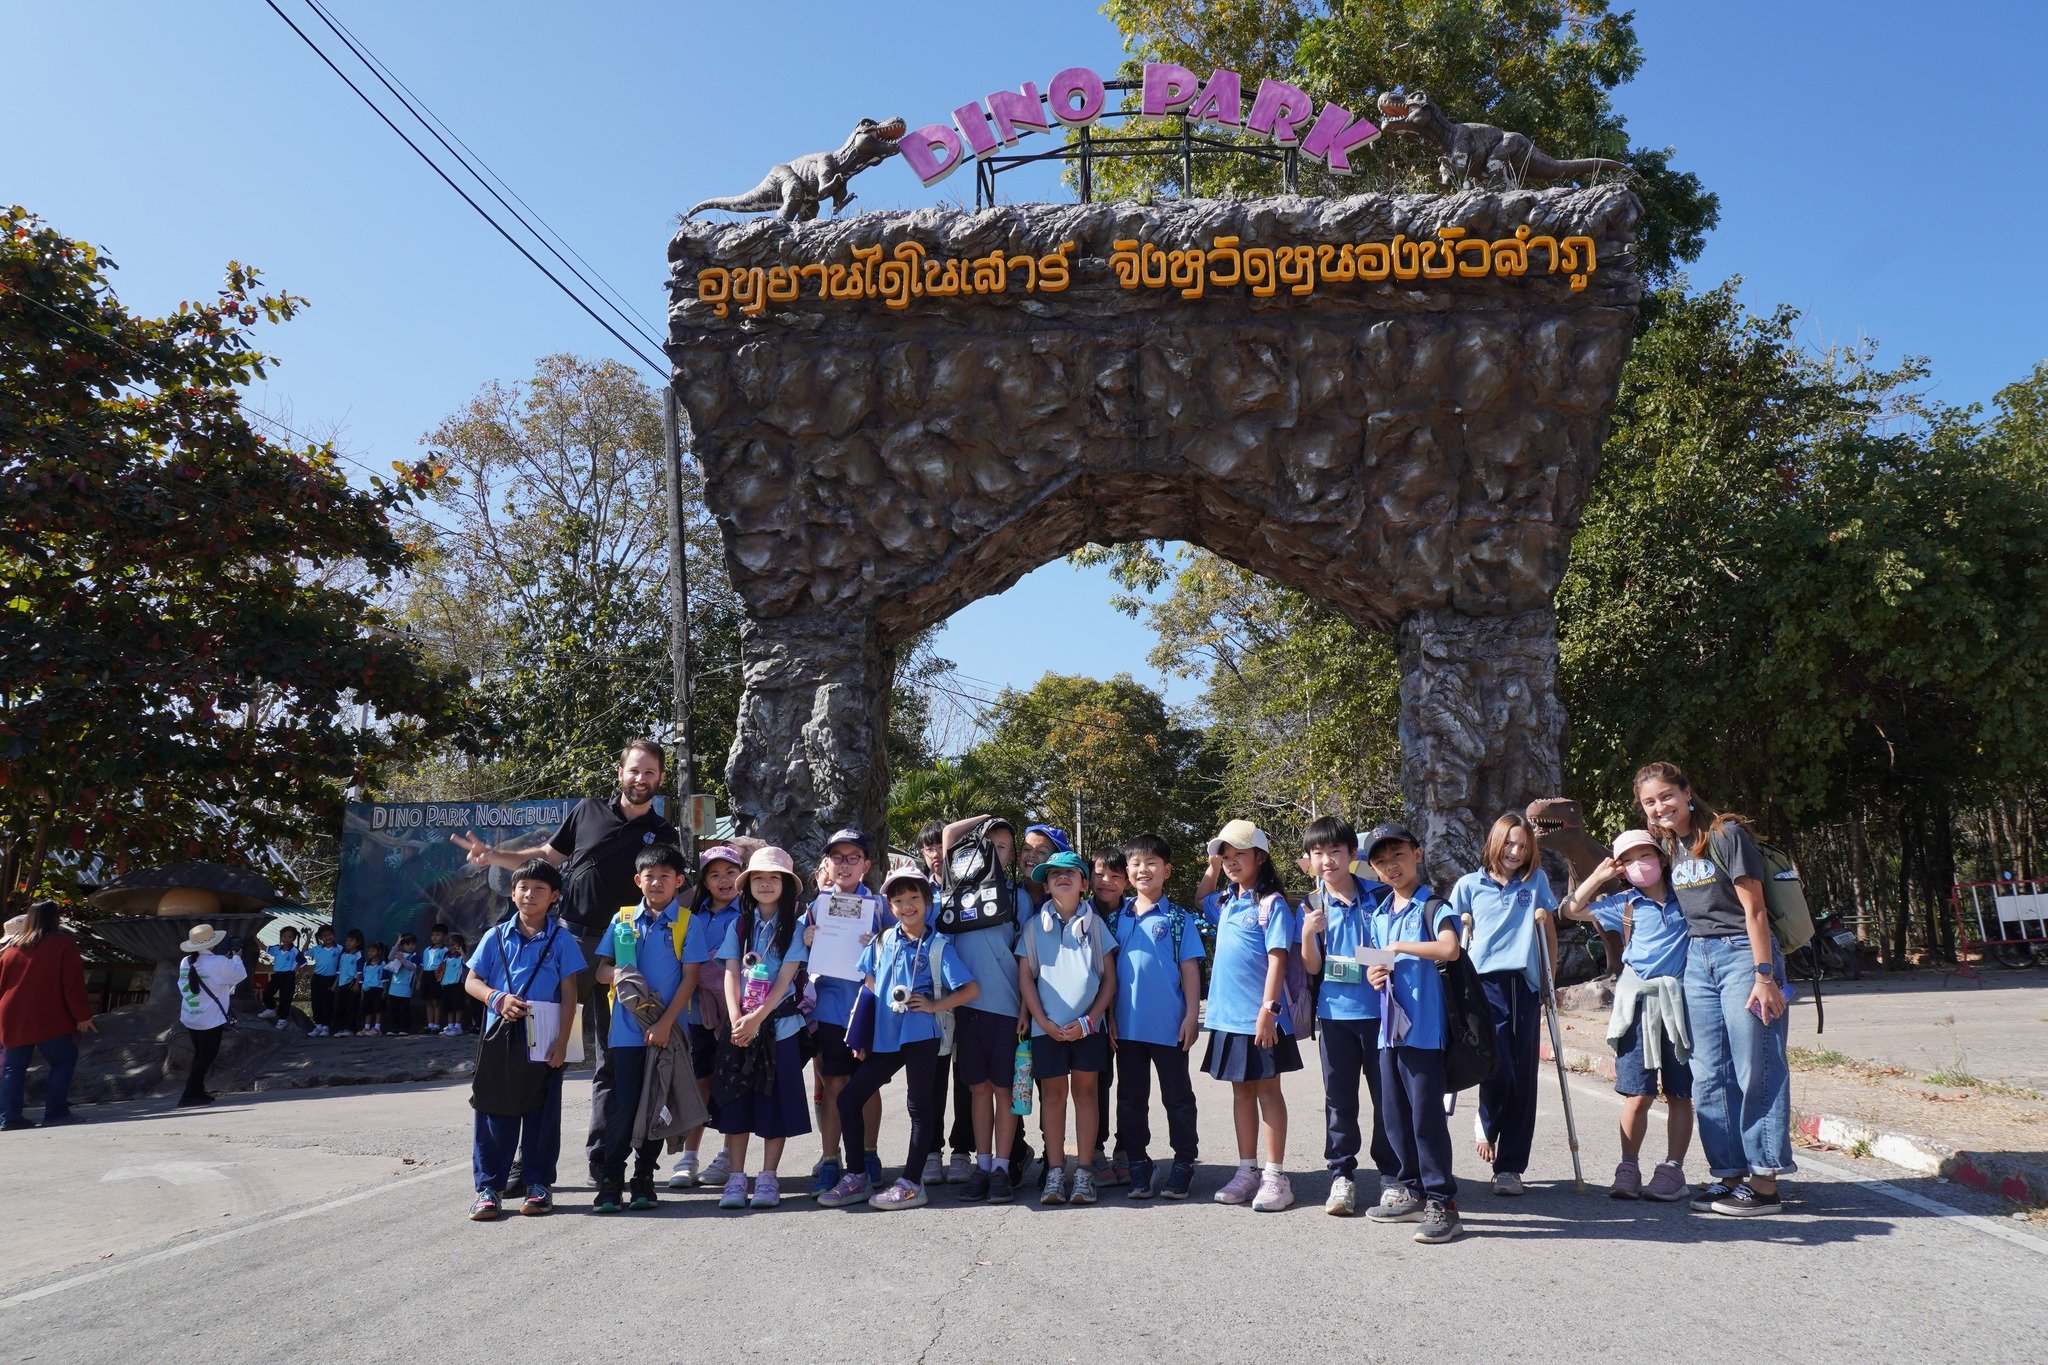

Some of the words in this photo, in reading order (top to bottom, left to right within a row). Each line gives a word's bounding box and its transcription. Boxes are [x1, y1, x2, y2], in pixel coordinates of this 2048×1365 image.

[899, 67, 1106, 188] DINO
[1142, 63, 1381, 175] PARK
[698, 240, 1075, 318] อุทยานไดโนเสาร์
[1109, 225, 1596, 299] จังหวัดหนองบัวลำภู
[372, 806, 422, 829] DINO
[425, 805, 470, 827] PARK
